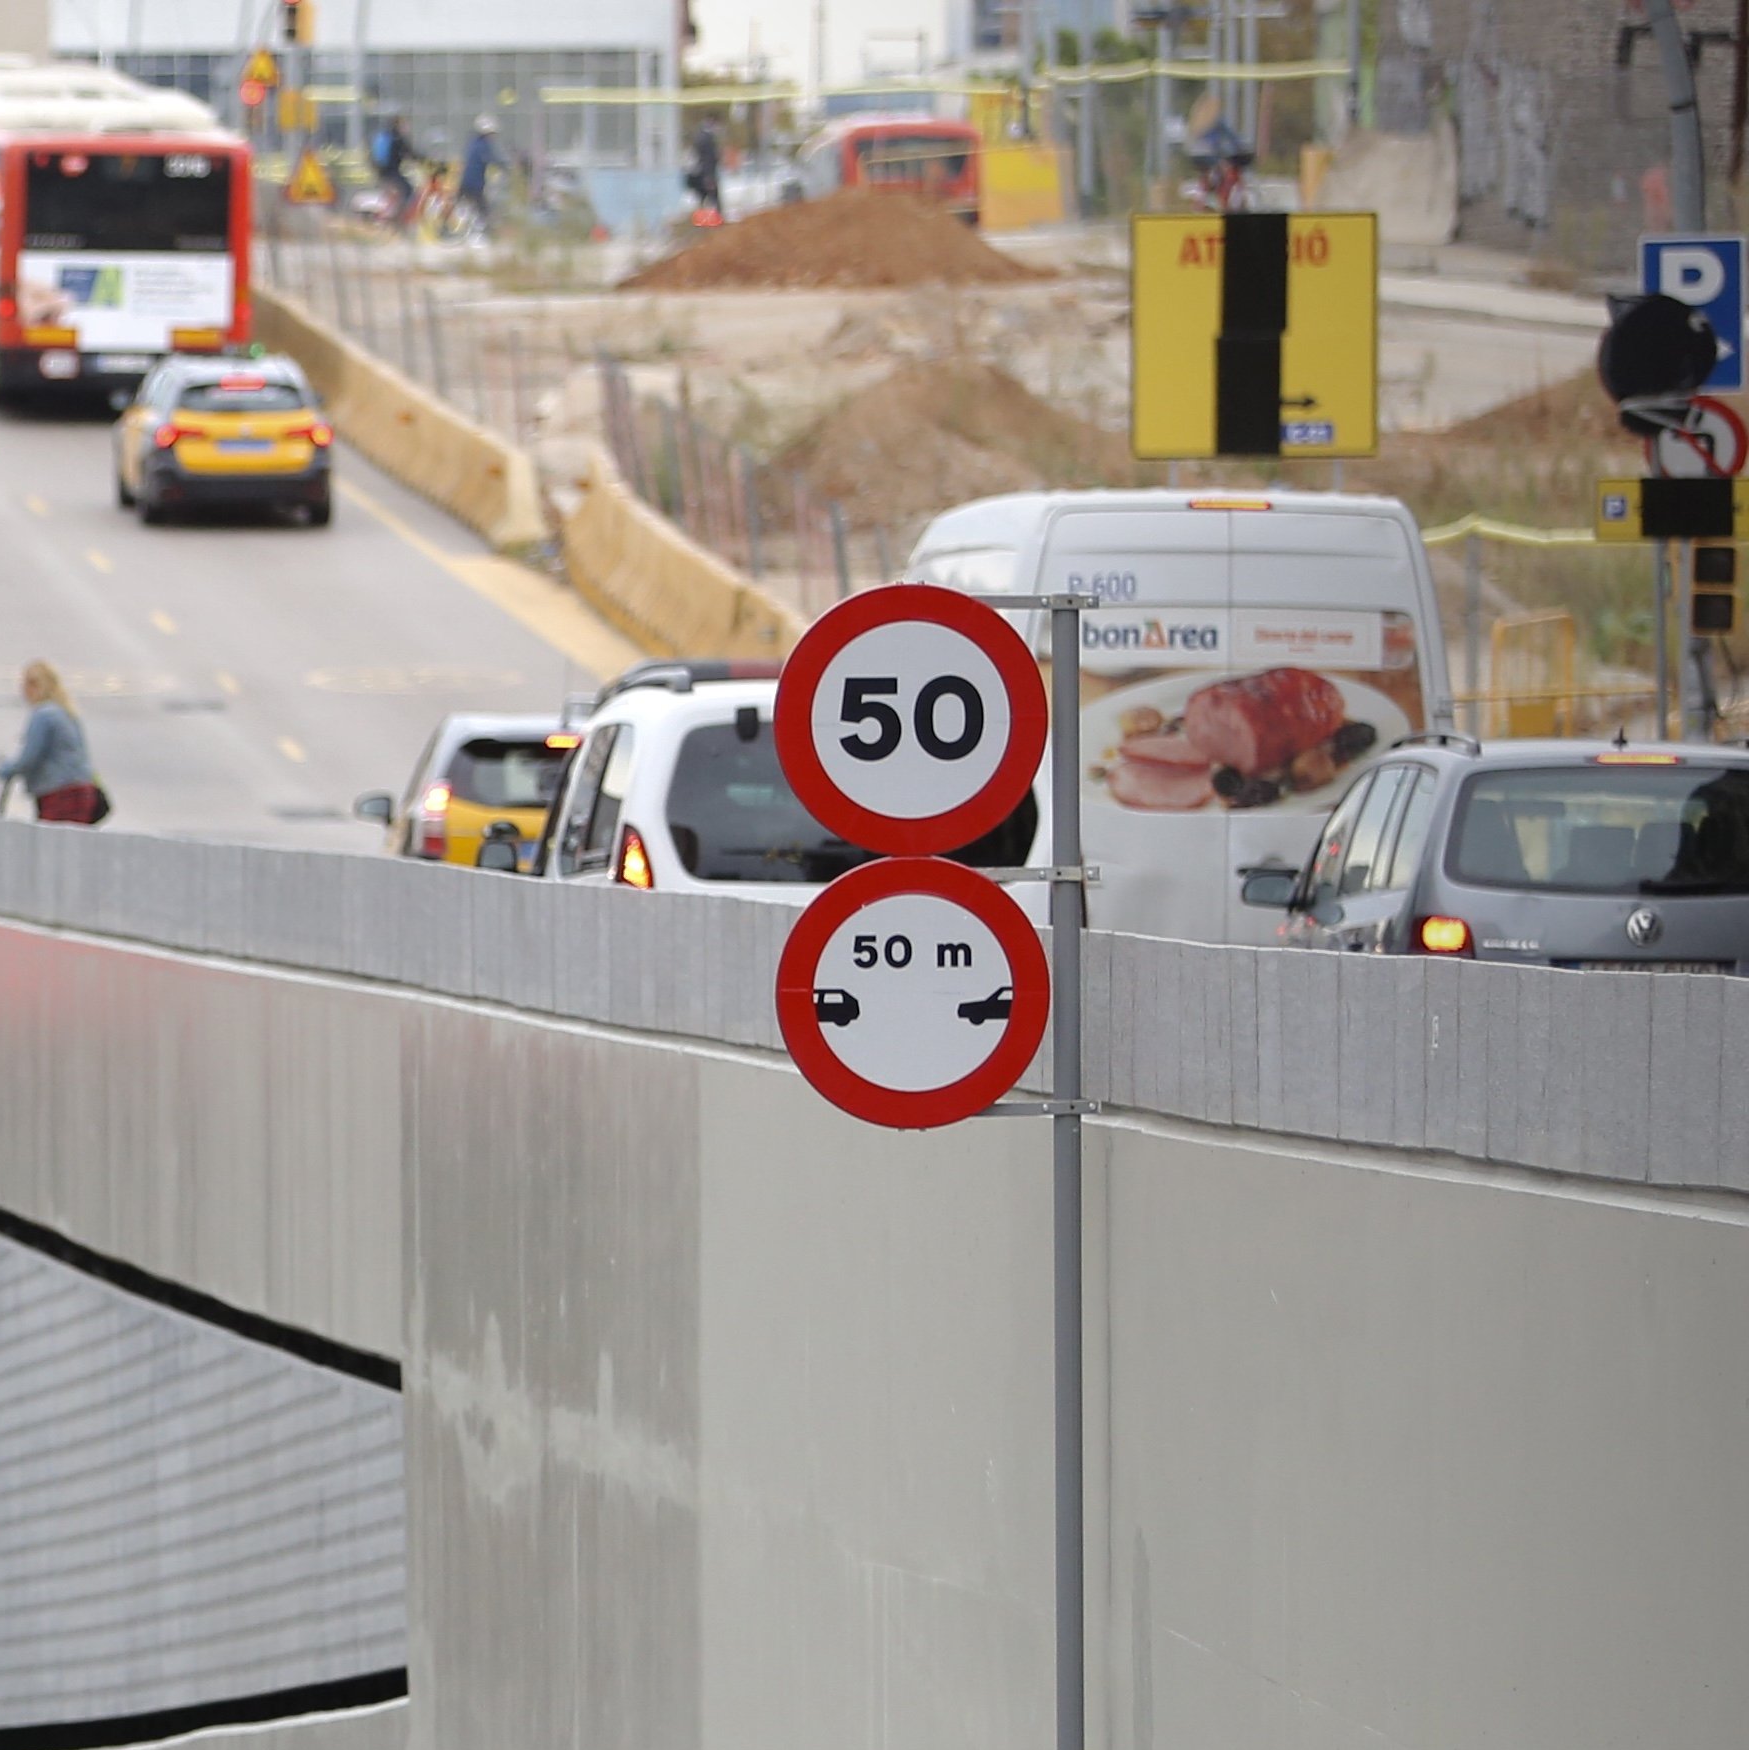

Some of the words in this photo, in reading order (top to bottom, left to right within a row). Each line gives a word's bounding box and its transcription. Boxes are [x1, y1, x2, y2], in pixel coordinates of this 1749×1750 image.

[839, 675, 985, 762] 50
[853, 935, 913, 968] 50
[937, 941, 972, 967] m
